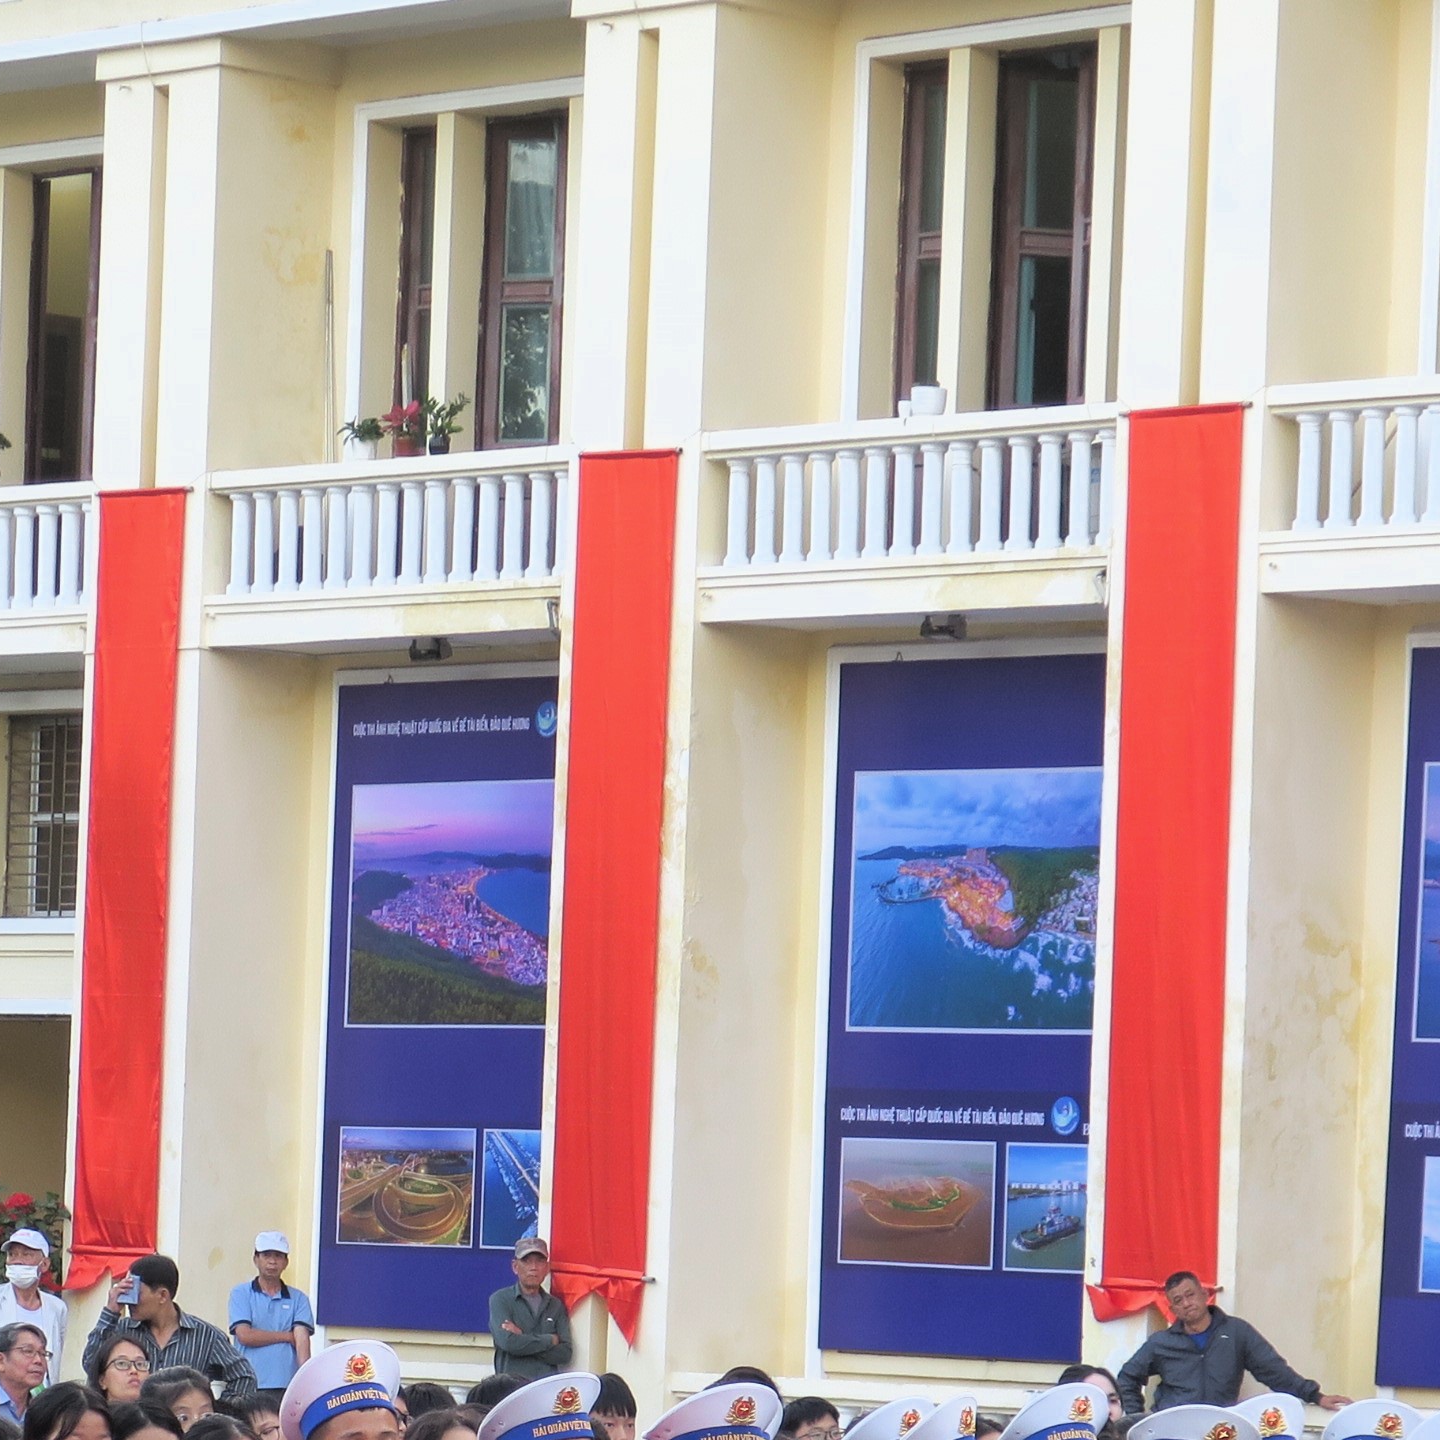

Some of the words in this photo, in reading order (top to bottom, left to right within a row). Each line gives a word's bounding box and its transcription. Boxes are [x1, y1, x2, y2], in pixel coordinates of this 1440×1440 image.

[326, 1396, 340, 1410] HẢI
[340, 1389, 362, 1404] QUÂN
[532, 1423, 548, 1438] HẢI
[548, 1420, 570, 1434] QUÂN
